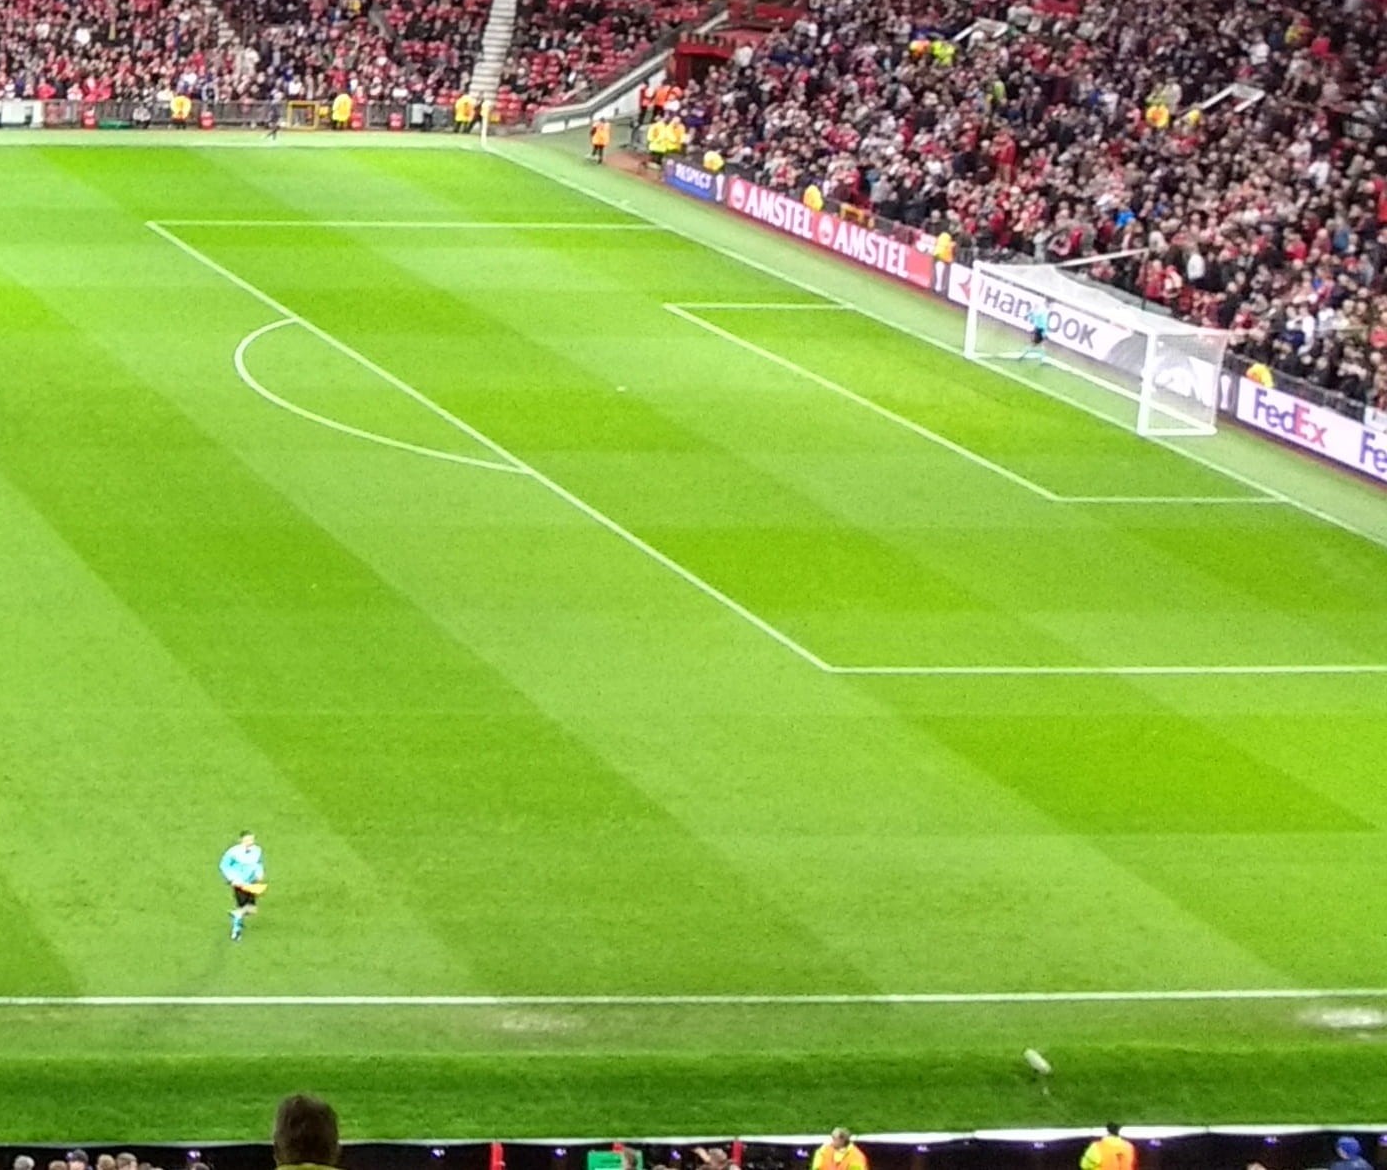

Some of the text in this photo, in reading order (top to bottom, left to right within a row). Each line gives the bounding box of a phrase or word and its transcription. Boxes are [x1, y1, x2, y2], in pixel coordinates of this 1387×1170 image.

[674, 160, 713, 190] RESPECT
[744, 186, 814, 239] AMSTEL
[833, 221, 910, 279] AMSTEL
[1253, 387, 1327, 448] FedEx
